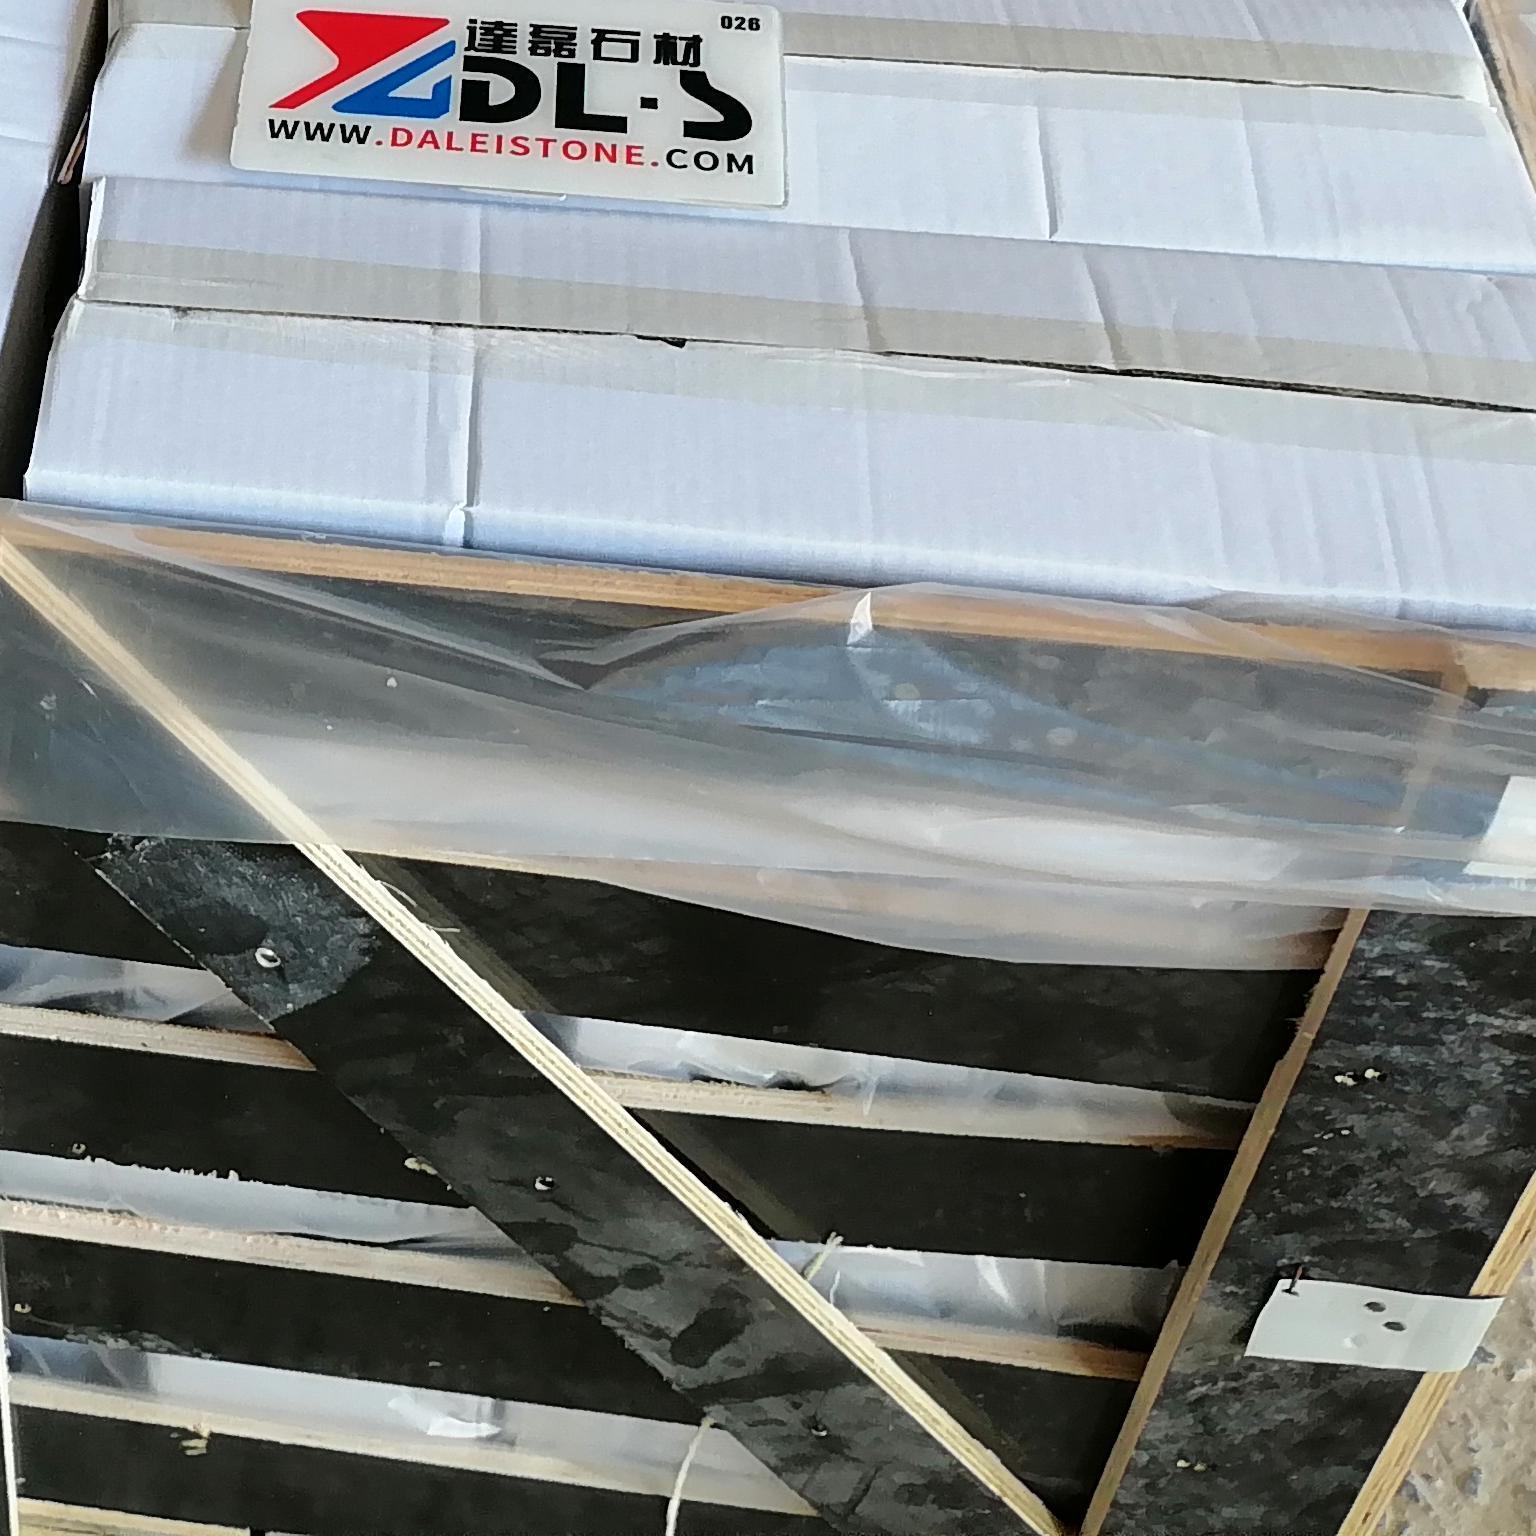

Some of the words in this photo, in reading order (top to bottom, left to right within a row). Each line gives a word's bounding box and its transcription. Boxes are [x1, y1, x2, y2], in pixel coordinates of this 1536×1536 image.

[463, 17, 703, 68] 達磊石材
[268, 117, 755, 175] WWW.DALEISTONE.COM
